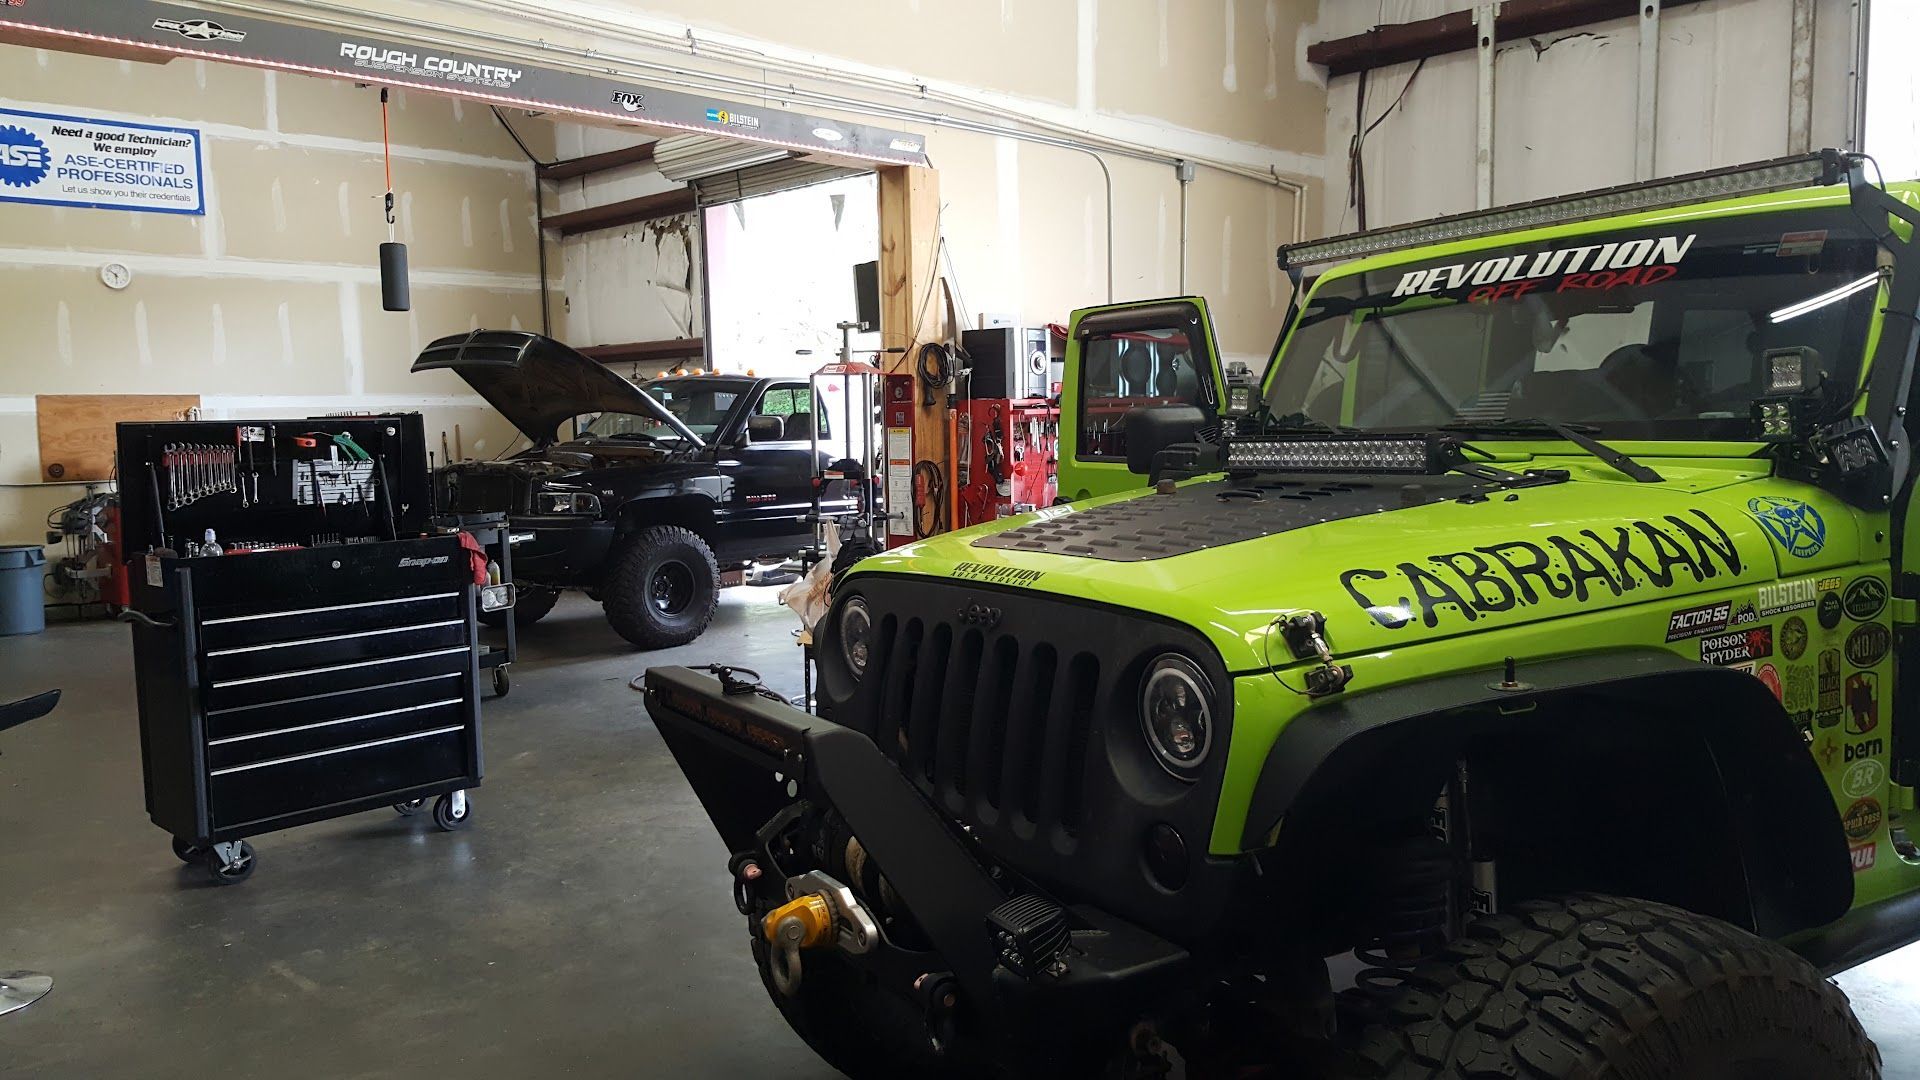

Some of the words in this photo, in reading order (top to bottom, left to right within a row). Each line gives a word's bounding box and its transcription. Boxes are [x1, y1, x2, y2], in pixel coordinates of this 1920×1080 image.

[340, 43, 417, 67] ROUGH
[424, 56, 522, 83] COUNTRY
[354, 59, 443, 79] SUSPENSION
[447, 73, 511, 89] SYSTEMS
[612, 91, 644, 107] FOX
[729, 113, 759, 127] BILSTEIN
[51, 125, 83, 138] Need
[85, 131, 93, 139] a
[95, 131, 125, 145] good
[127, 133, 192, 148] Technician?
[93, 142, 112, 153] We
[114, 145, 157, 158] employ
[64, 154, 185, 175] ASE-CERTIFIED
[57, 167, 194, 189] PROFESSIONALS
[62, 184, 76, 193] Let
[89, 186, 112, 196] show
[114, 189, 129, 199] you
[130, 190, 147, 199] their
[148, 191, 191, 202] credentials
[1392, 234, 1697, 298] REVOLUTION
[1467, 279, 1547, 303] OFF
[1556, 264, 1678, 293] ROAD
[398, 556, 449, 568] Snap-on
[954, 562, 1047, 581] REVOLUTION
[1340, 508, 1743, 629] CABRAKAN
[950, 571, 978, 579] AUTO
[984, 575, 1034, 587] SERVICE
[1819, 578, 1841, 591] JEGS
[1758, 578, 1816, 609] BILSTEIN
[1670, 609, 1713, 630] FACTOR
[1713, 606, 1730, 622] 55
[1737, 612, 1754, 623] POD
[1761, 607, 1781, 617] SHOCK
[1782, 601, 1815, 613] ABSORBERS
[1668, 630, 1692, 640] PRECISION
[1693, 624, 1726, 635] ENGINEERING
[1702, 633, 1747, 653] POISON
[1702, 646, 1752, 665] SPYDER
[1844, 738, 1883, 763] bern
[1852, 766, 1875, 789] BR
